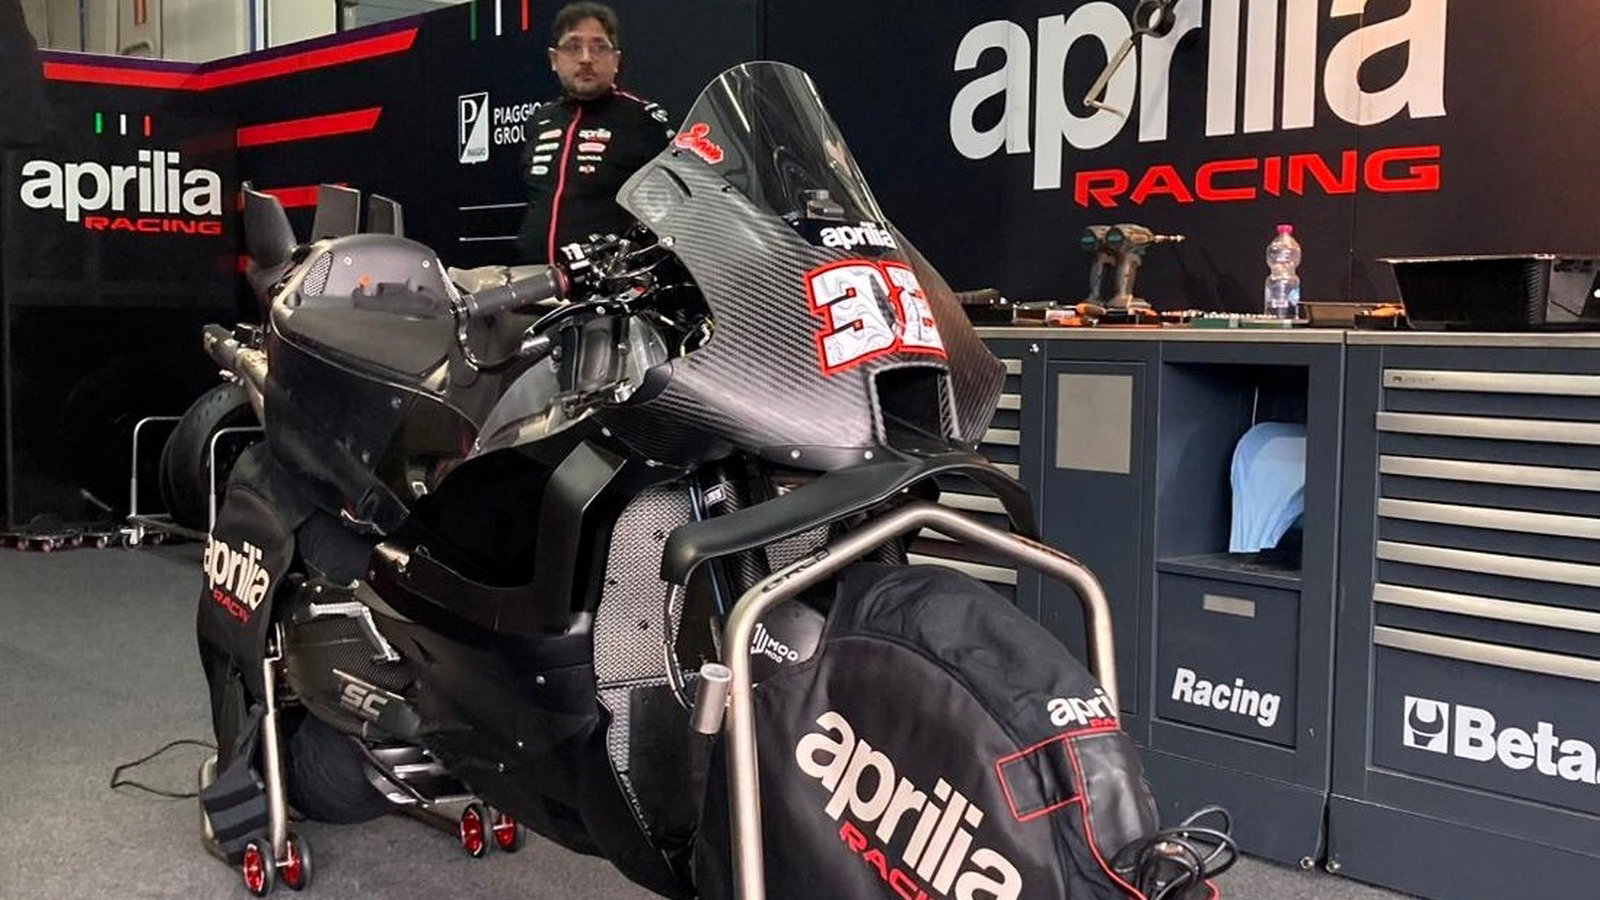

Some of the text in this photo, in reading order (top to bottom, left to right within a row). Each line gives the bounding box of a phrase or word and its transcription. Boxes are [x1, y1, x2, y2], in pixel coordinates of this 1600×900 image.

[950, 0, 1446, 189] aprilia
[493, 125, 526, 145] GRO
[19, 149, 222, 222] aprilia
[1073, 144, 1441, 208] RACING
[84, 216, 222, 235] RACING
[819, 221, 897, 250] aprilia
[203, 533, 270, 611] aprilia
[767, 638, 799, 661] MOO
[341, 682, 388, 720] SC
[1047, 687, 1117, 727] apri
[1172, 667, 1281, 727] Racing
[795, 711, 1023, 900] aprilia
